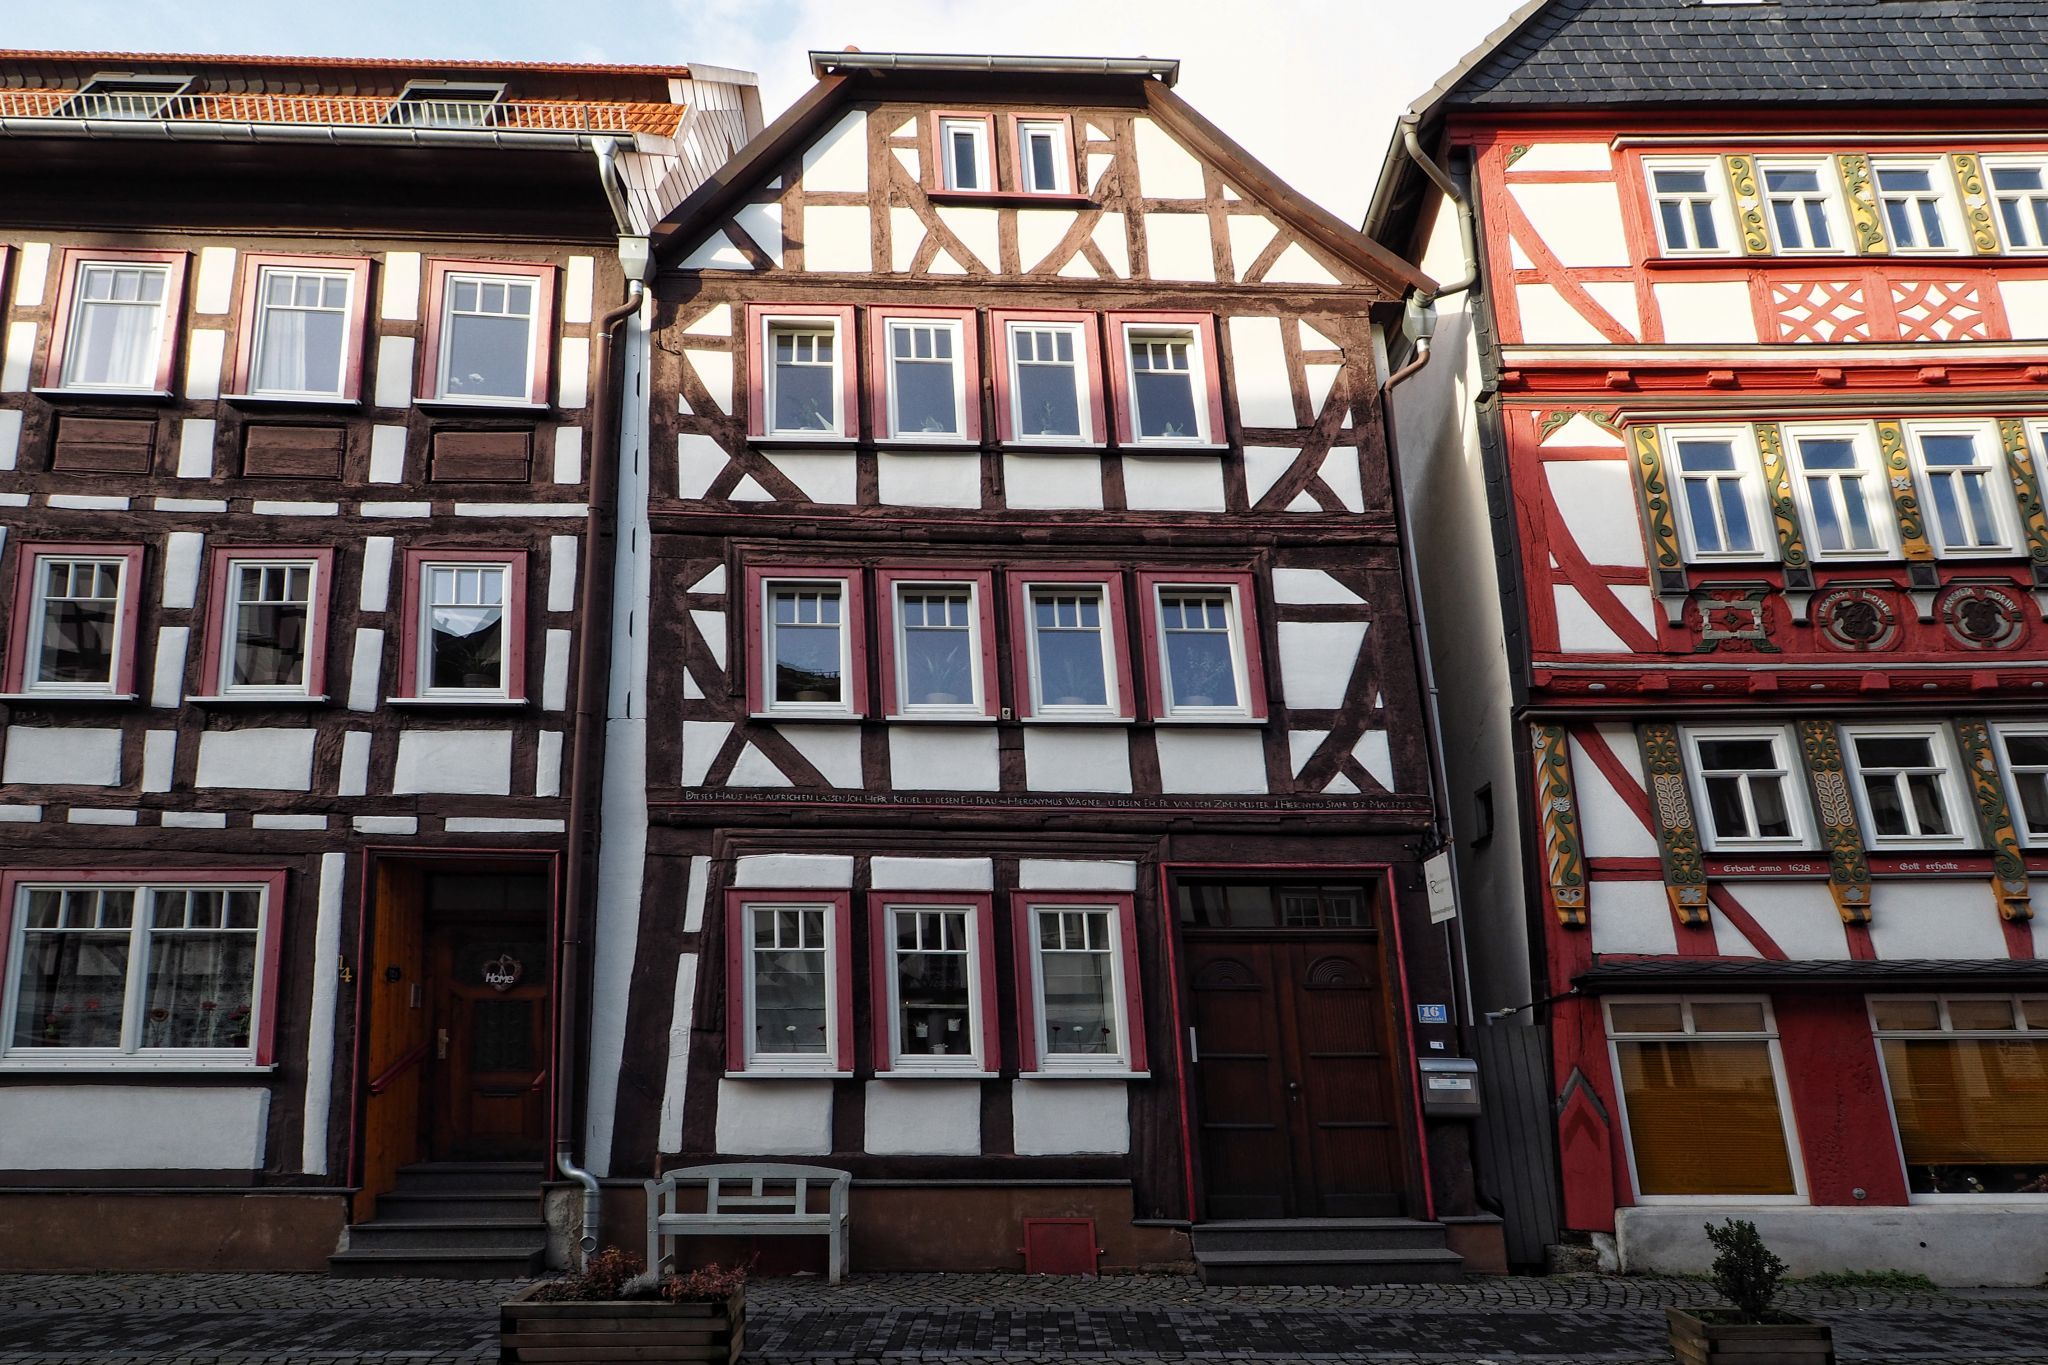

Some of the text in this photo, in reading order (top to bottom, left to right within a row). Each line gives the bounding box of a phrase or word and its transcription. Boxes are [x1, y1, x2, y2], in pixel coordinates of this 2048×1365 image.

[1723, 863, 1811, 873] Erbaut anno 1628
[1899, 862, 1959, 873] Gott erhalte
[338, 955, 353, 983] 14
[1422, 1006, 1440, 1017] 16
